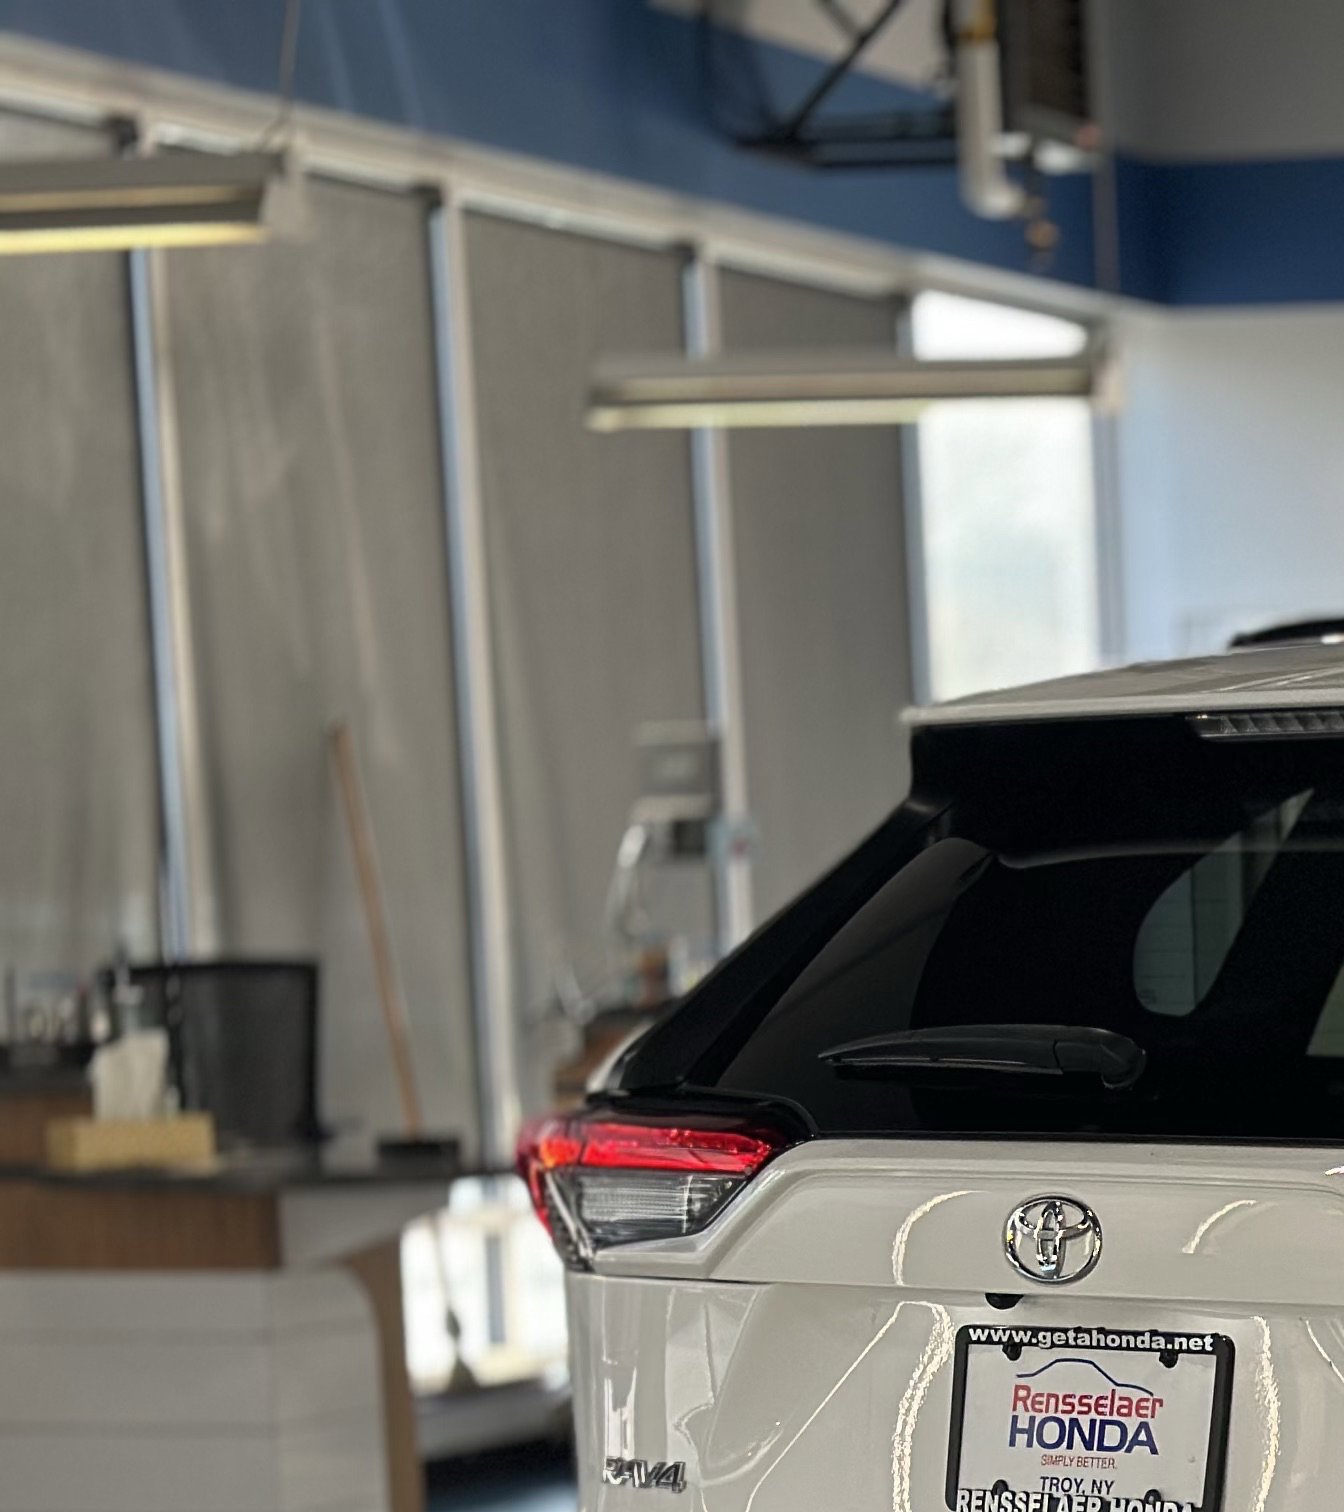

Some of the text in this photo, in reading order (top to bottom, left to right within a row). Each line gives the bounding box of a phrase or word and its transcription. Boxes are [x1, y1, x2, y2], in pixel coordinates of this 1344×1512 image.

[968, 1328, 1214, 1351] www.getahonda.net
[1012, 1384, 1164, 1419] Rensselaer
[1008, 1415, 1159, 1455] HONDA
[602, 1456, 687, 1494] RAV4
[1040, 1454, 1075, 1467] SIMPLY
[1039, 1476, 1115, 1496] TROY, NY
